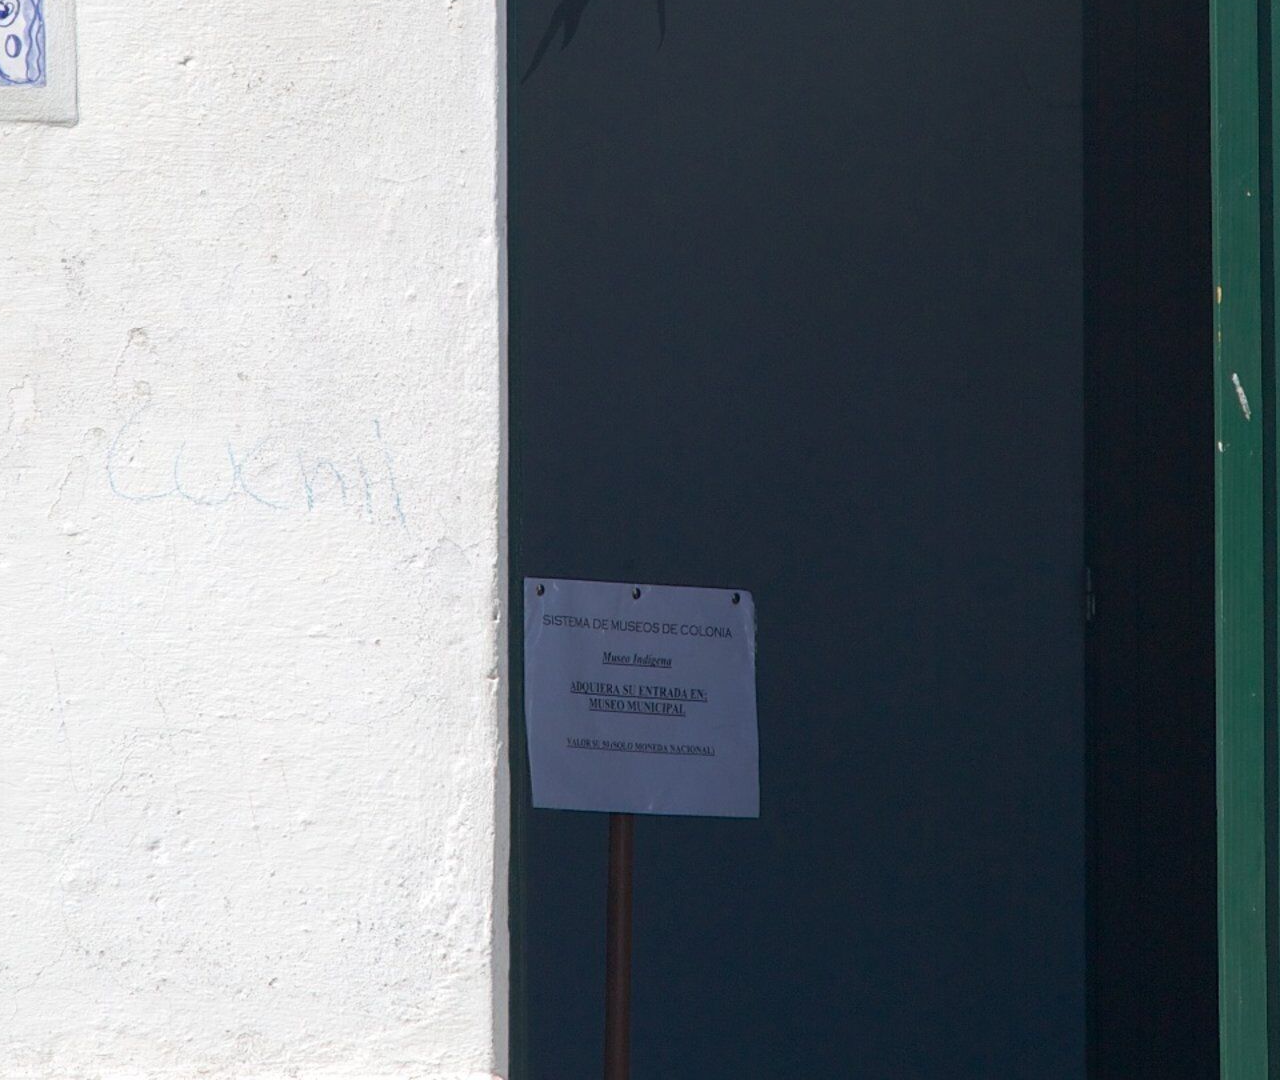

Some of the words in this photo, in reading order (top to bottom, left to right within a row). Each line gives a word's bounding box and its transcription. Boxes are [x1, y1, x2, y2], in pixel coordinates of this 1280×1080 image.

[543, 614, 590, 629] SISTEMA
[592, 618, 609, 631] DE
[610, 619, 660, 634] MUSEOS
[662, 622, 678, 635] DE
[680, 624, 733, 638] COLONIA
[602, 651, 630, 664] Museo
[570, 681, 619, 695] ADQUIERA
[638, 686, 686, 699] ENTRADA
[589, 698, 625, 711] MUSEO
[627, 701, 685, 716] MUNICIPAL
